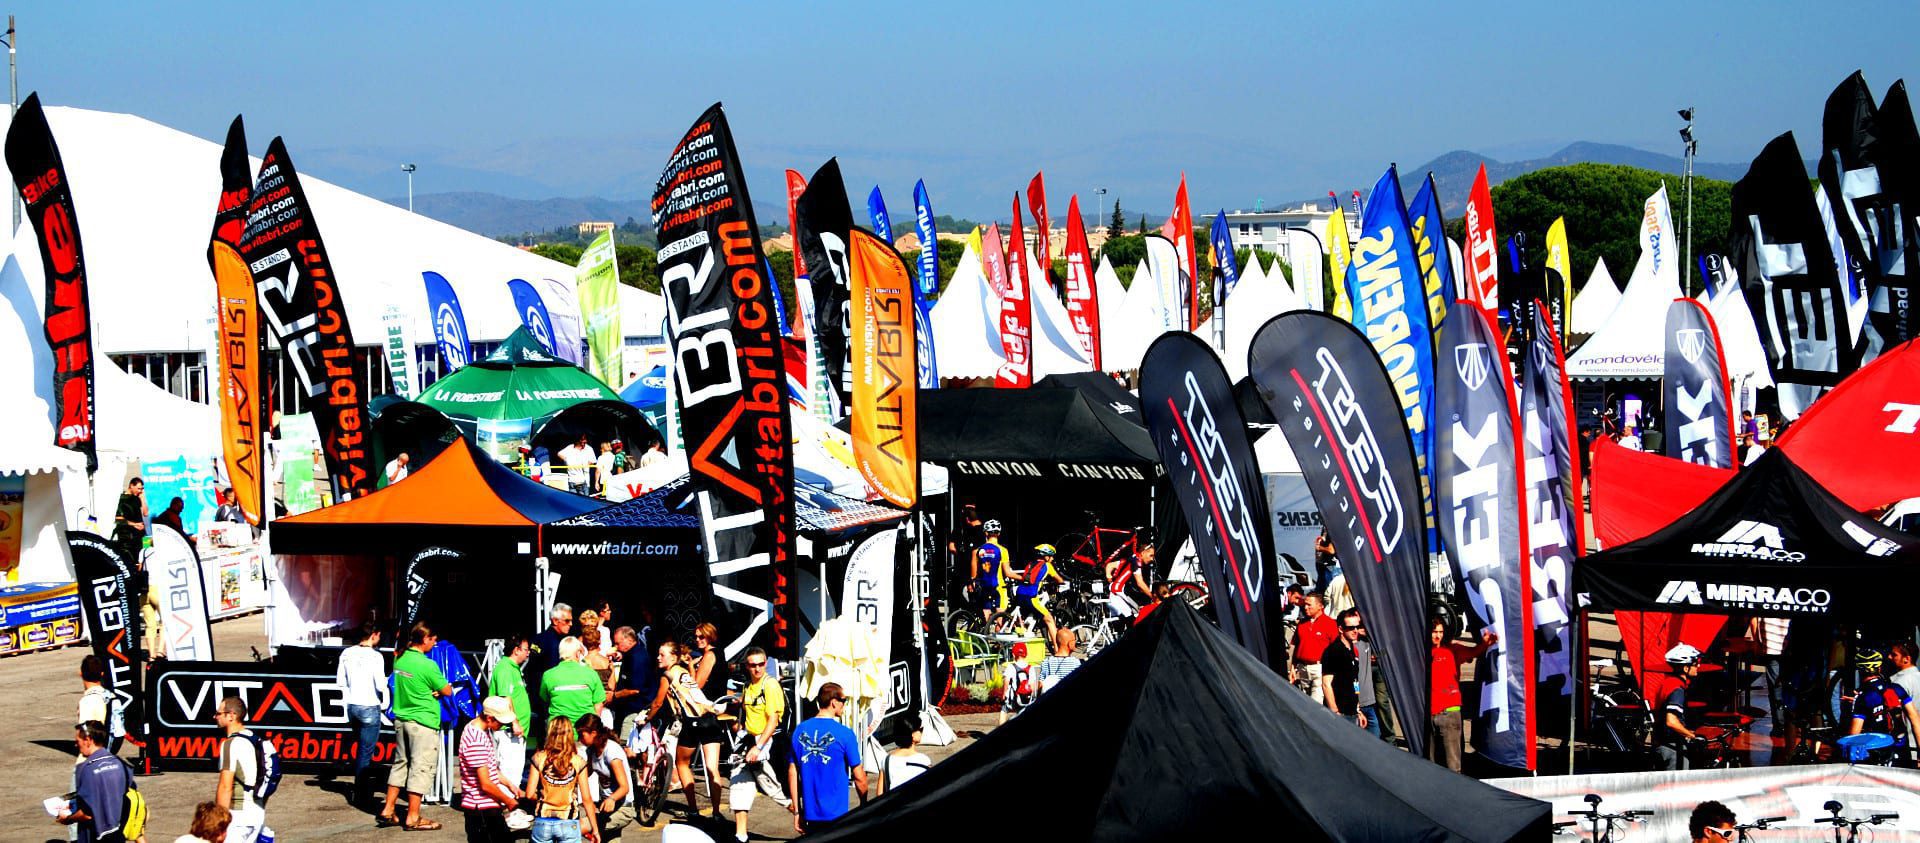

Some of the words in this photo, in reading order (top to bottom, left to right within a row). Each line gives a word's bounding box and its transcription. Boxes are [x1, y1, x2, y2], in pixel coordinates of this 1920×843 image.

[22, 168, 60, 205] Bike
[673, 232, 706, 253] STANDS
[917, 205, 936, 290] SHIMANO
[957, 460, 1042, 477] CANYON
[1057, 463, 1145, 480] CANYON
[551, 540, 679, 556] www.vitabri.com
[1690, 543, 1806, 561] MIRRACO
[1706, 583, 1832, 608] MIRRACO
[1762, 603, 1829, 613] COMPANY
[167, 680, 395, 726] VITAB
